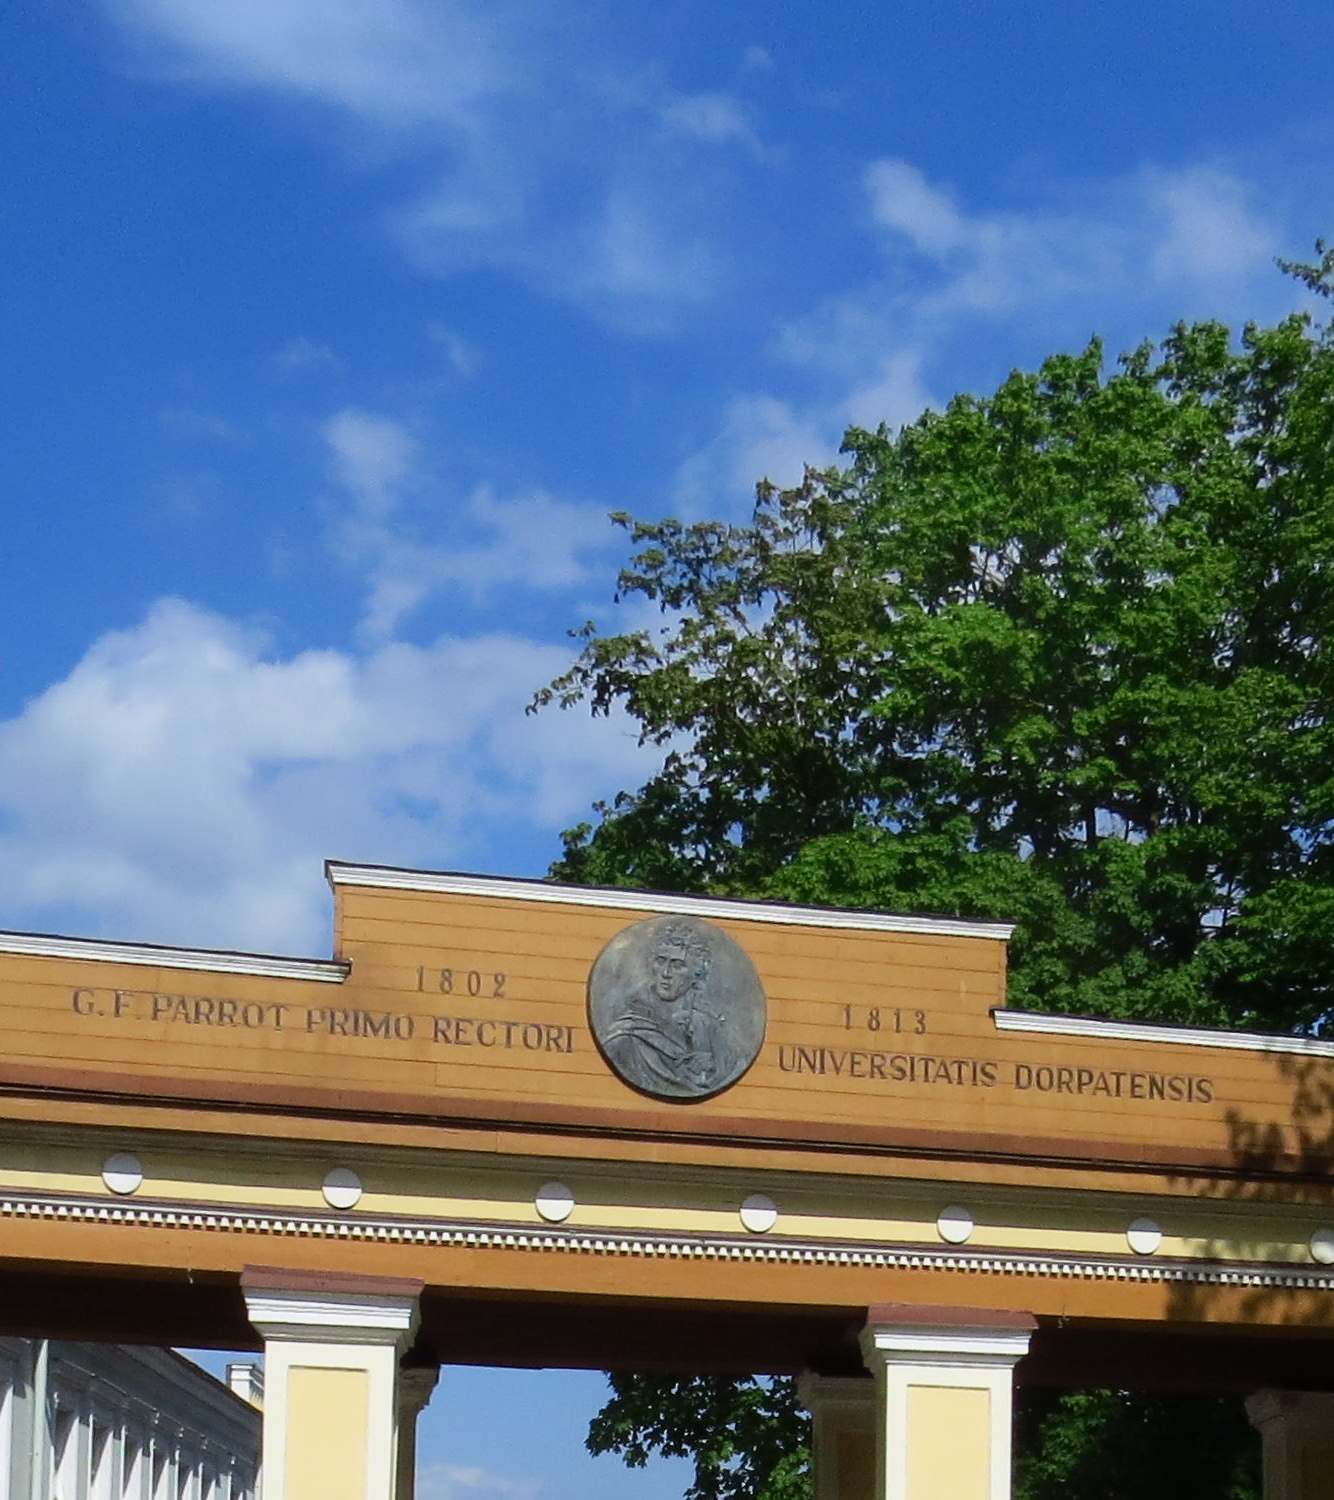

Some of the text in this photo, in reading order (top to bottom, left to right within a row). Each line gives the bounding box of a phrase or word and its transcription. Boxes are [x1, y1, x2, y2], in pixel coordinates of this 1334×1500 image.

[416, 965, 507, 999] 1802
[151, 994, 290, 1032] PARROT
[305, 1008, 415, 1041] PRIMO
[432, 1015, 576, 1054] RECTORI
[843, 1004, 927, 1035] 1813
[777, 1045, 1215, 1104] UNIVERSITATIS DORPATENSIS
